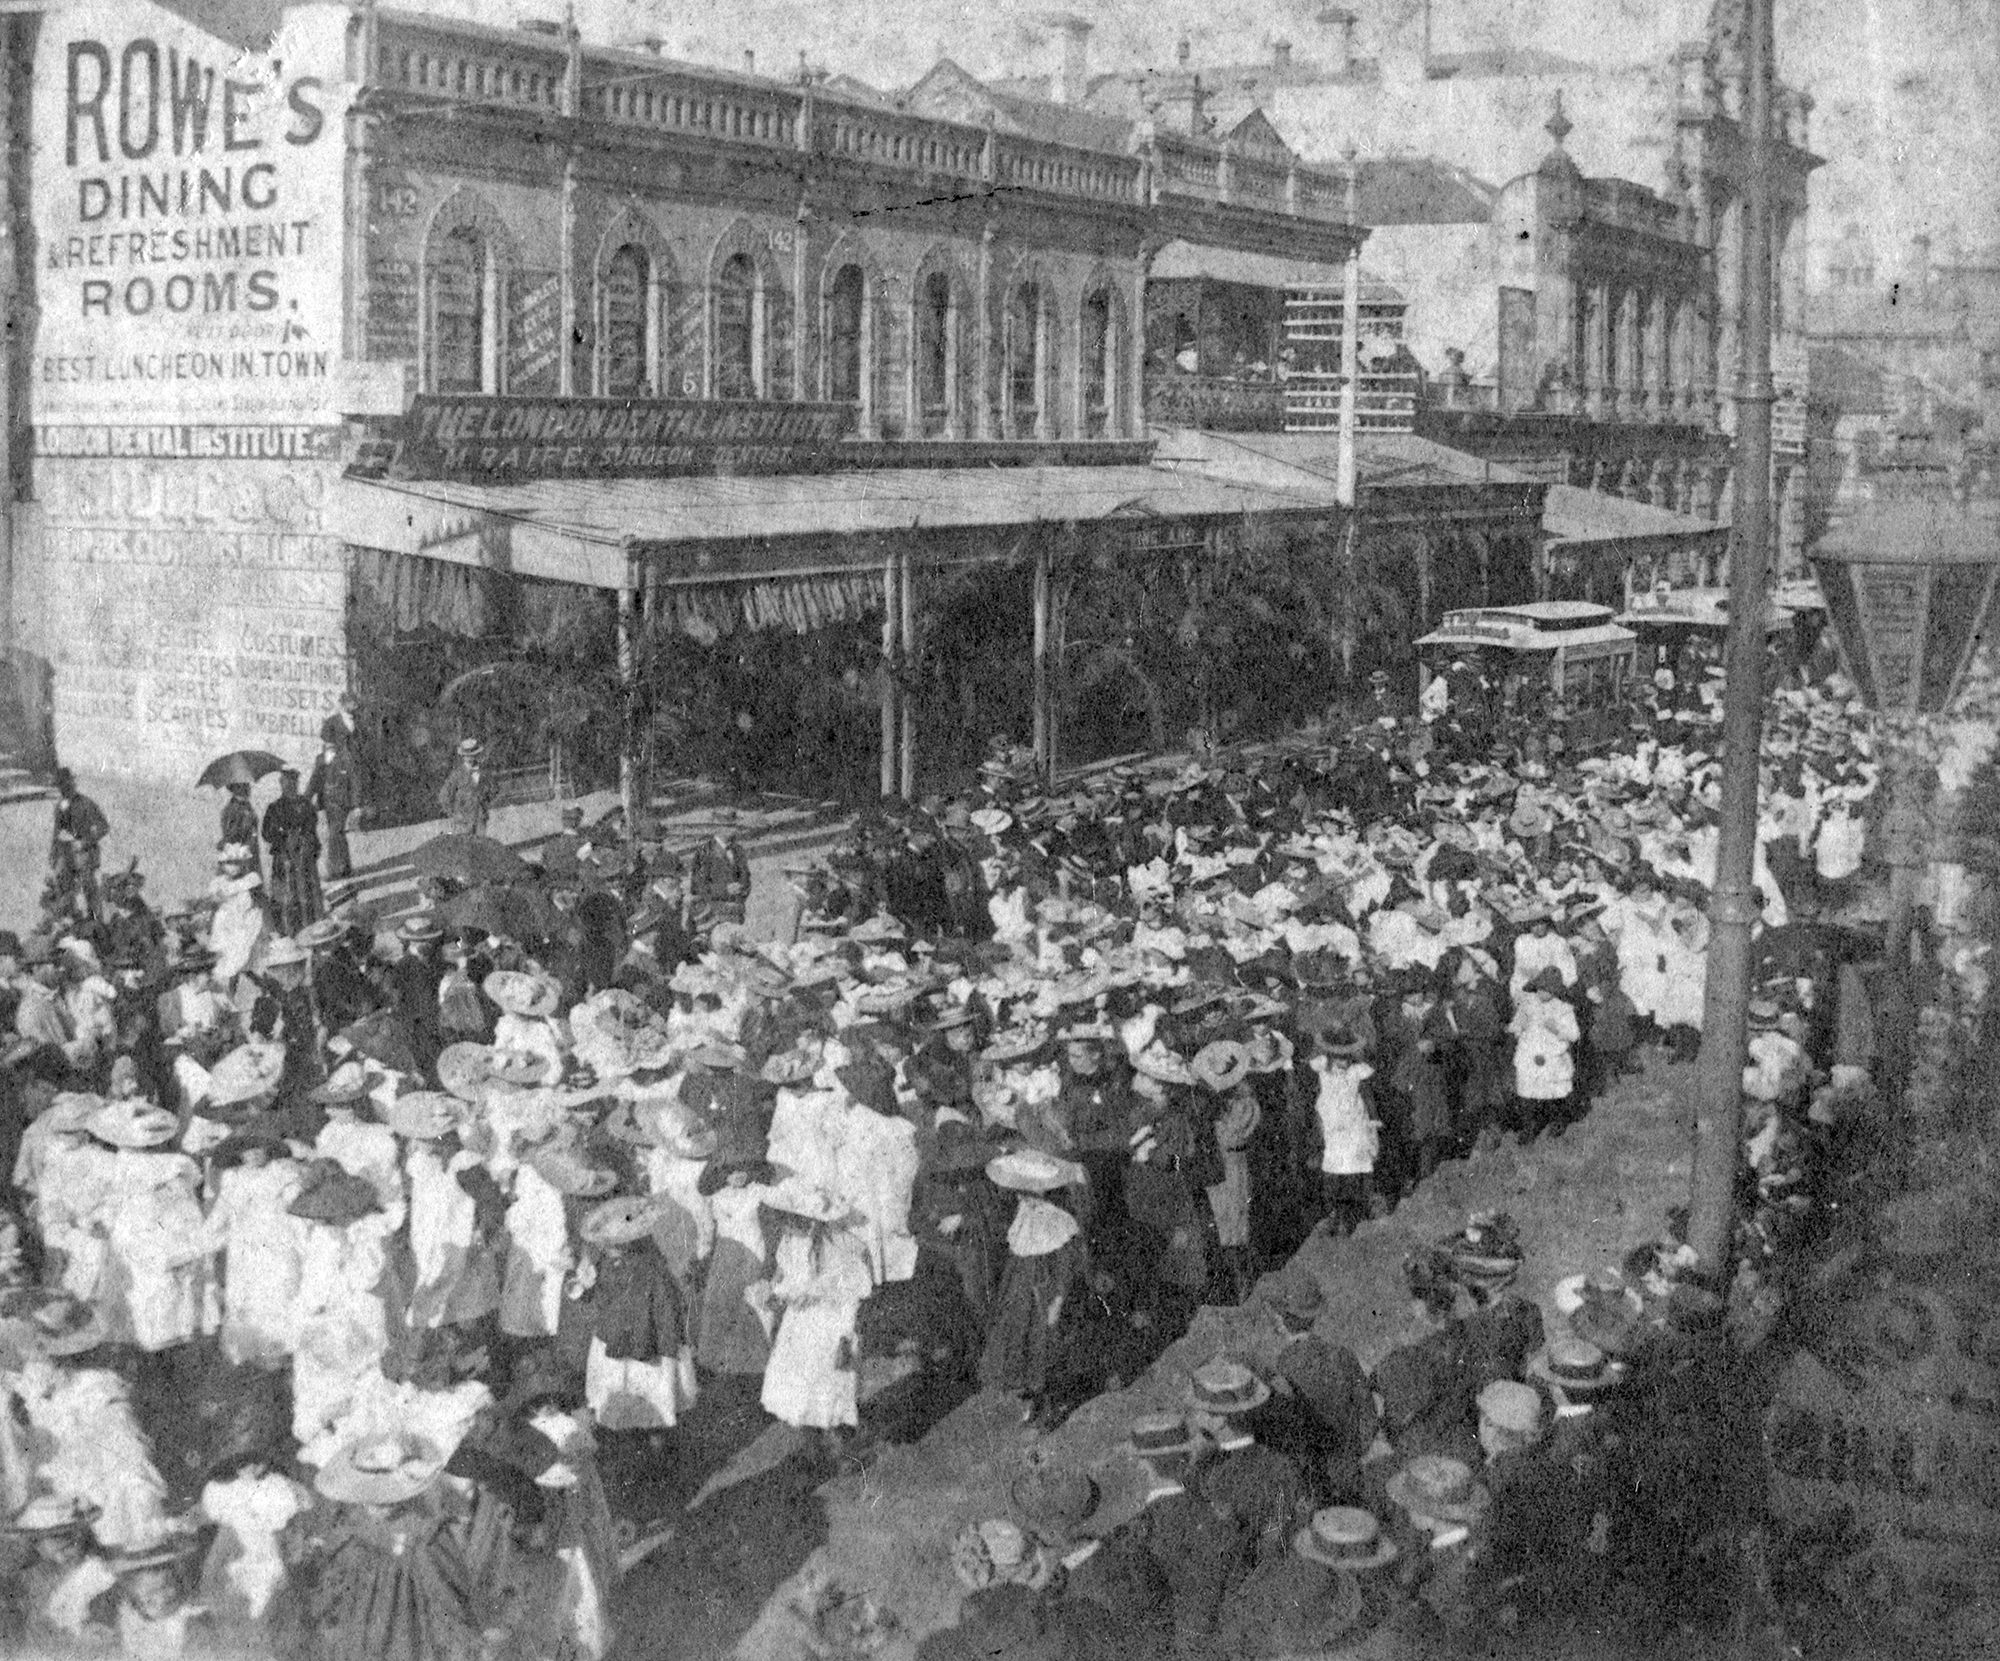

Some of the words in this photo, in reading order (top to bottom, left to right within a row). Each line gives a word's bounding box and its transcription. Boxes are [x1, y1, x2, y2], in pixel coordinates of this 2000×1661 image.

[66, 38, 324, 166] ROWE'S
[79, 163, 278, 222] DINING
[380, 187, 417, 215] 142
[67, 221, 311, 268] REFRESHMENT
[768, 229, 794, 252] 142
[42, 355, 97, 383] BEST
[104, 351, 225, 381] LUNCHEON
[260, 350, 328, 378] TOWN
[603, 408, 708, 439] DENTAL
[191, 427, 310, 458] INSTITUTE
[600, 446, 694, 466] SURGEON
[242, 708, 321, 737] UMBRELL
